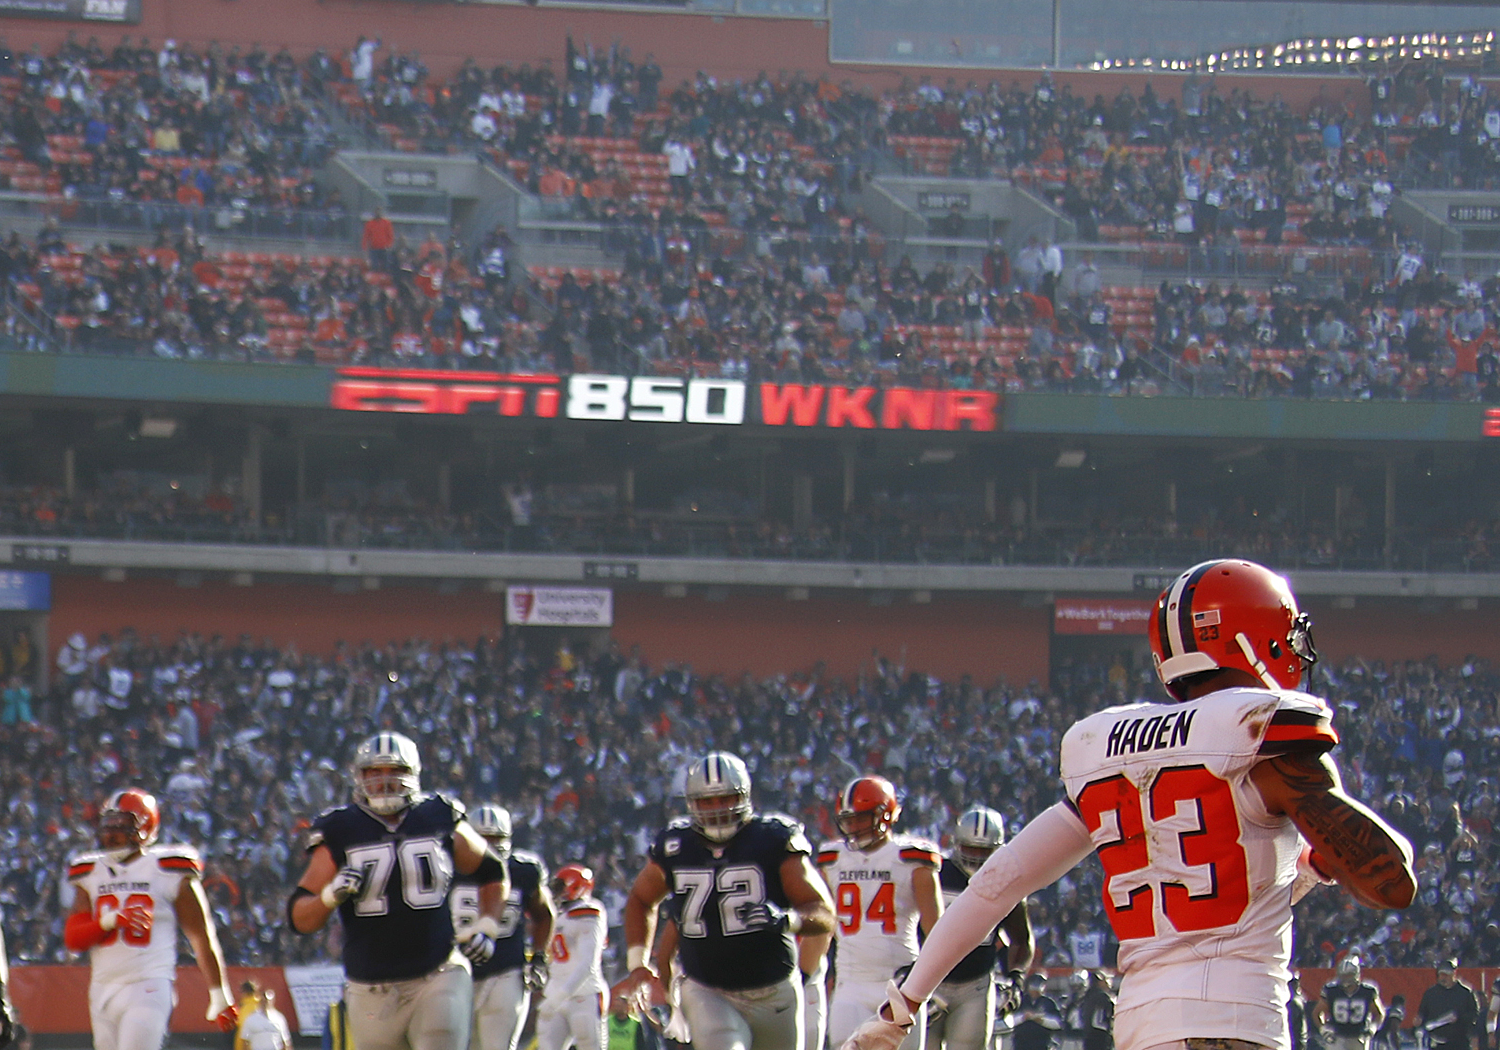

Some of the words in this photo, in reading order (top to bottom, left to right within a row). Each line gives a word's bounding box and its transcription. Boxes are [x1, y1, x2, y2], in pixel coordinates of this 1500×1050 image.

[566, 374, 746, 426] 850
[760, 382, 1000, 432] WKNR
[538, 590, 606, 609] University
[538, 608, 599, 624] Hospitals
[1199, 626, 1220, 642] 23
[1106, 709, 1198, 758] HADEN
[1076, 764, 1250, 942] 23
[98, 882, 151, 895] CLEVELAND
[345, 838, 454, 917] 70
[839, 870, 891, 882] CLEVELAND
[672, 865, 766, 939] 72
[837, 882, 897, 937] 94
[1332, 998, 1367, 1025] 63
